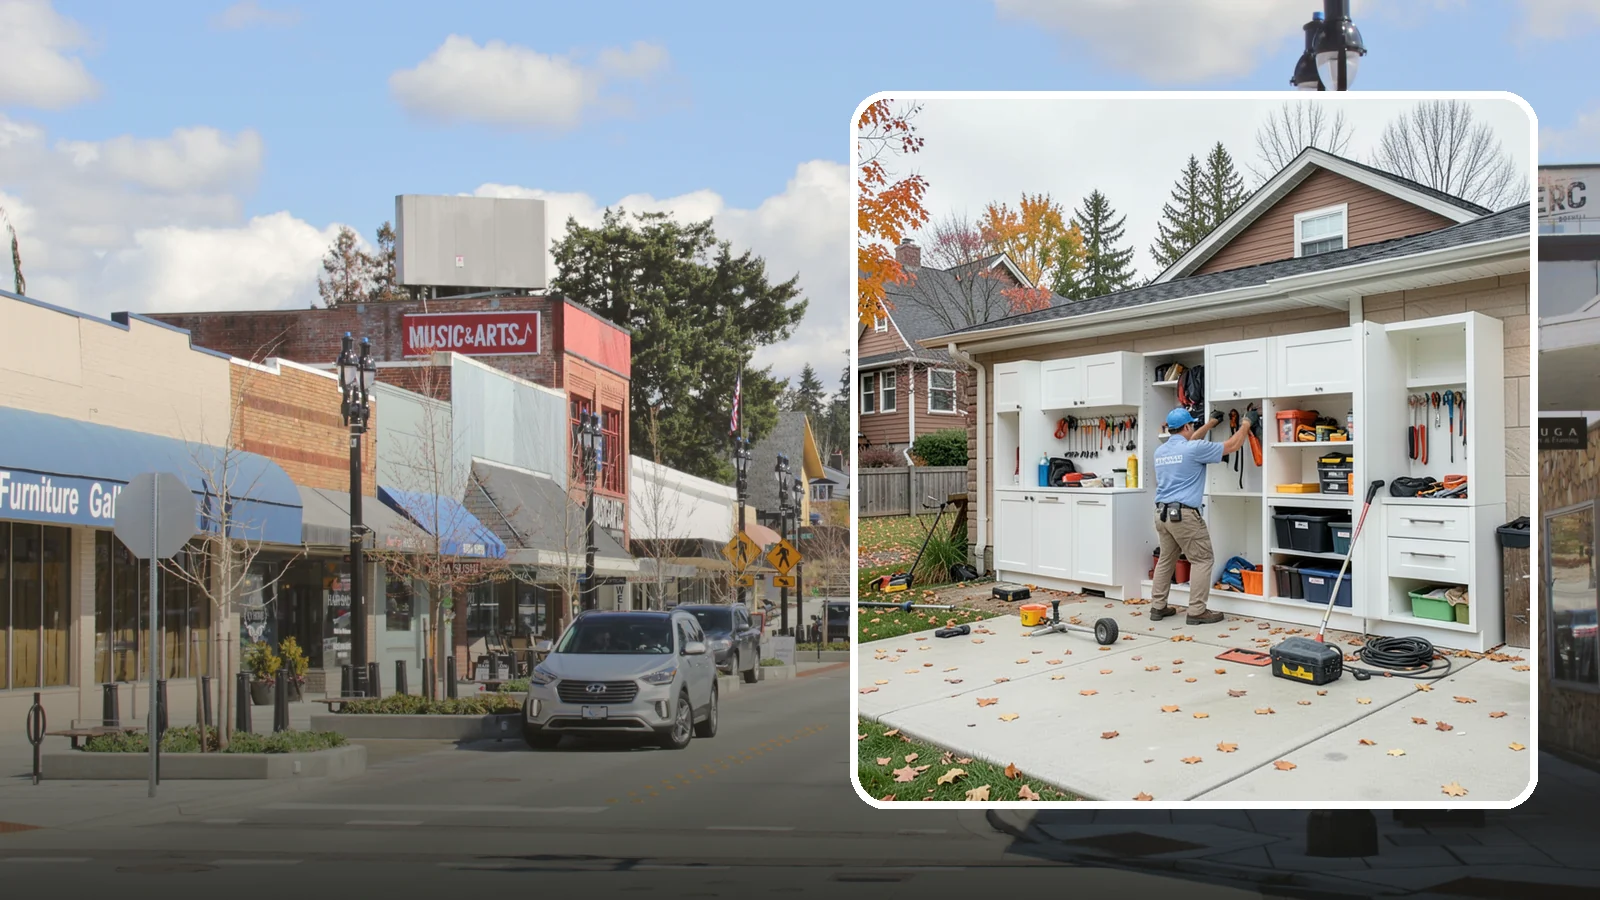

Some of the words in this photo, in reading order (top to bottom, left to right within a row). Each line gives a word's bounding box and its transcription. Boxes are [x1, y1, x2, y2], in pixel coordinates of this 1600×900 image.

[0, 471, 79, 515] Furniture
[89, 482, 122, 519] Gal
[453, 563, 480, 574] SUSHI
